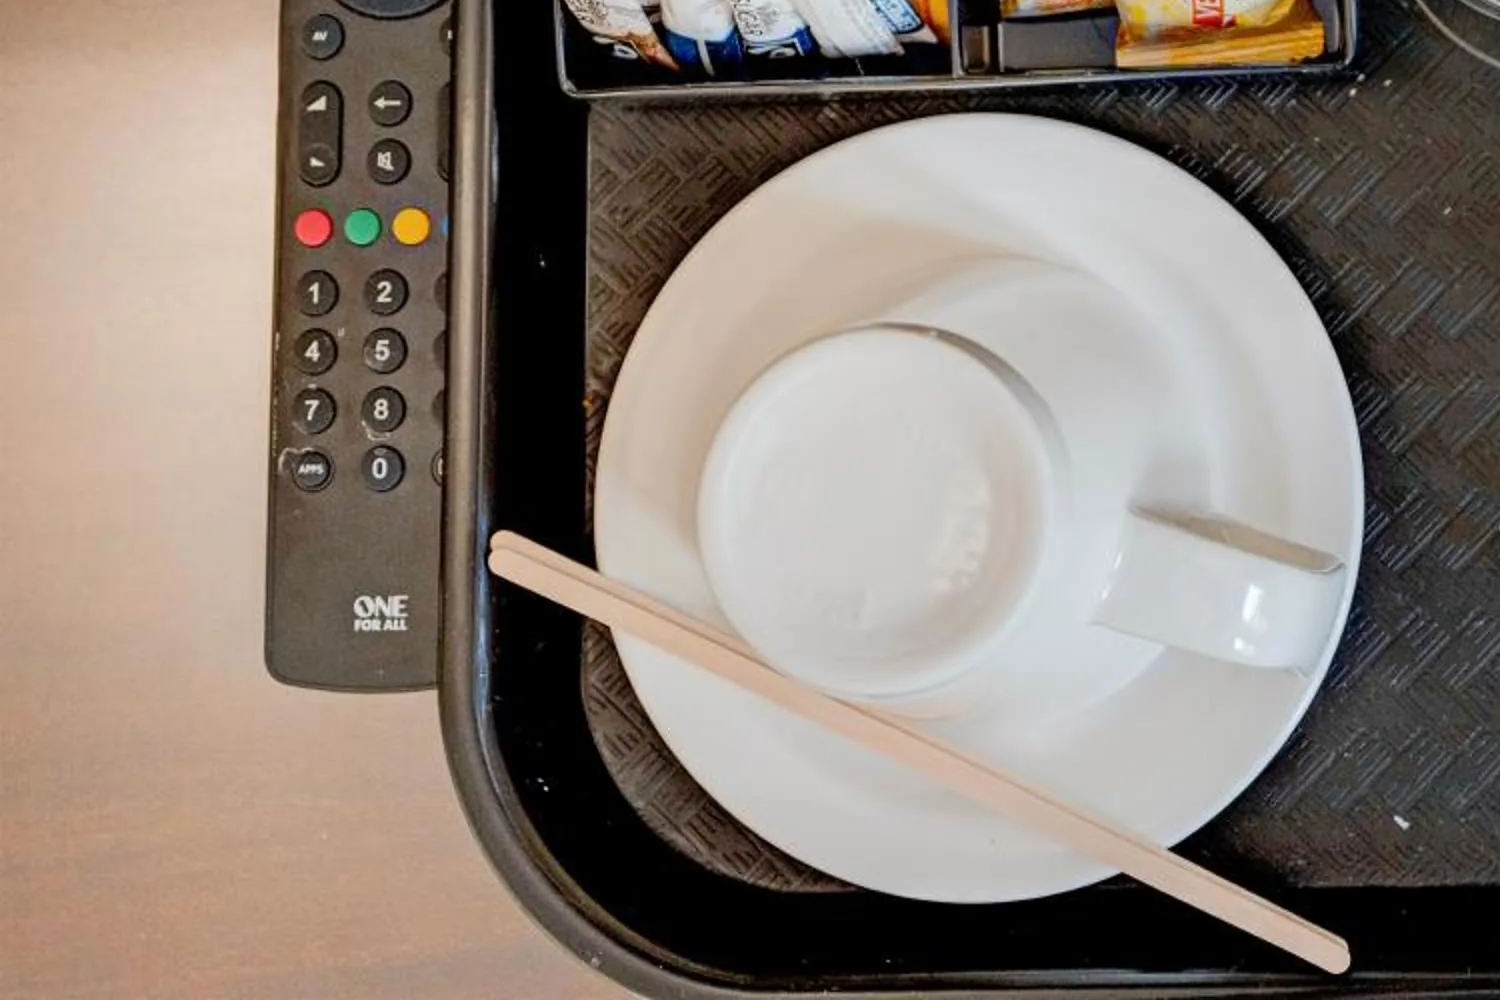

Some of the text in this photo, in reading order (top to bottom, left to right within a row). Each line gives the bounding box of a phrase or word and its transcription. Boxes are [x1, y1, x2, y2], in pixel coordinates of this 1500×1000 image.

[312, 29, 329, 41] AV
[307, 281, 320, 305] 1
[375, 280, 393, 303] 2
[304, 340, 321, 362] 4
[375, 339, 391, 361] 5
[304, 400, 320, 421] 7
[373, 398, 390, 420] 8
[299, 462, 325, 475] APPS
[371, 457, 388, 480] 0
[353, 594, 409, 618] ONE
[353, 618, 408, 633] FOR ALL
